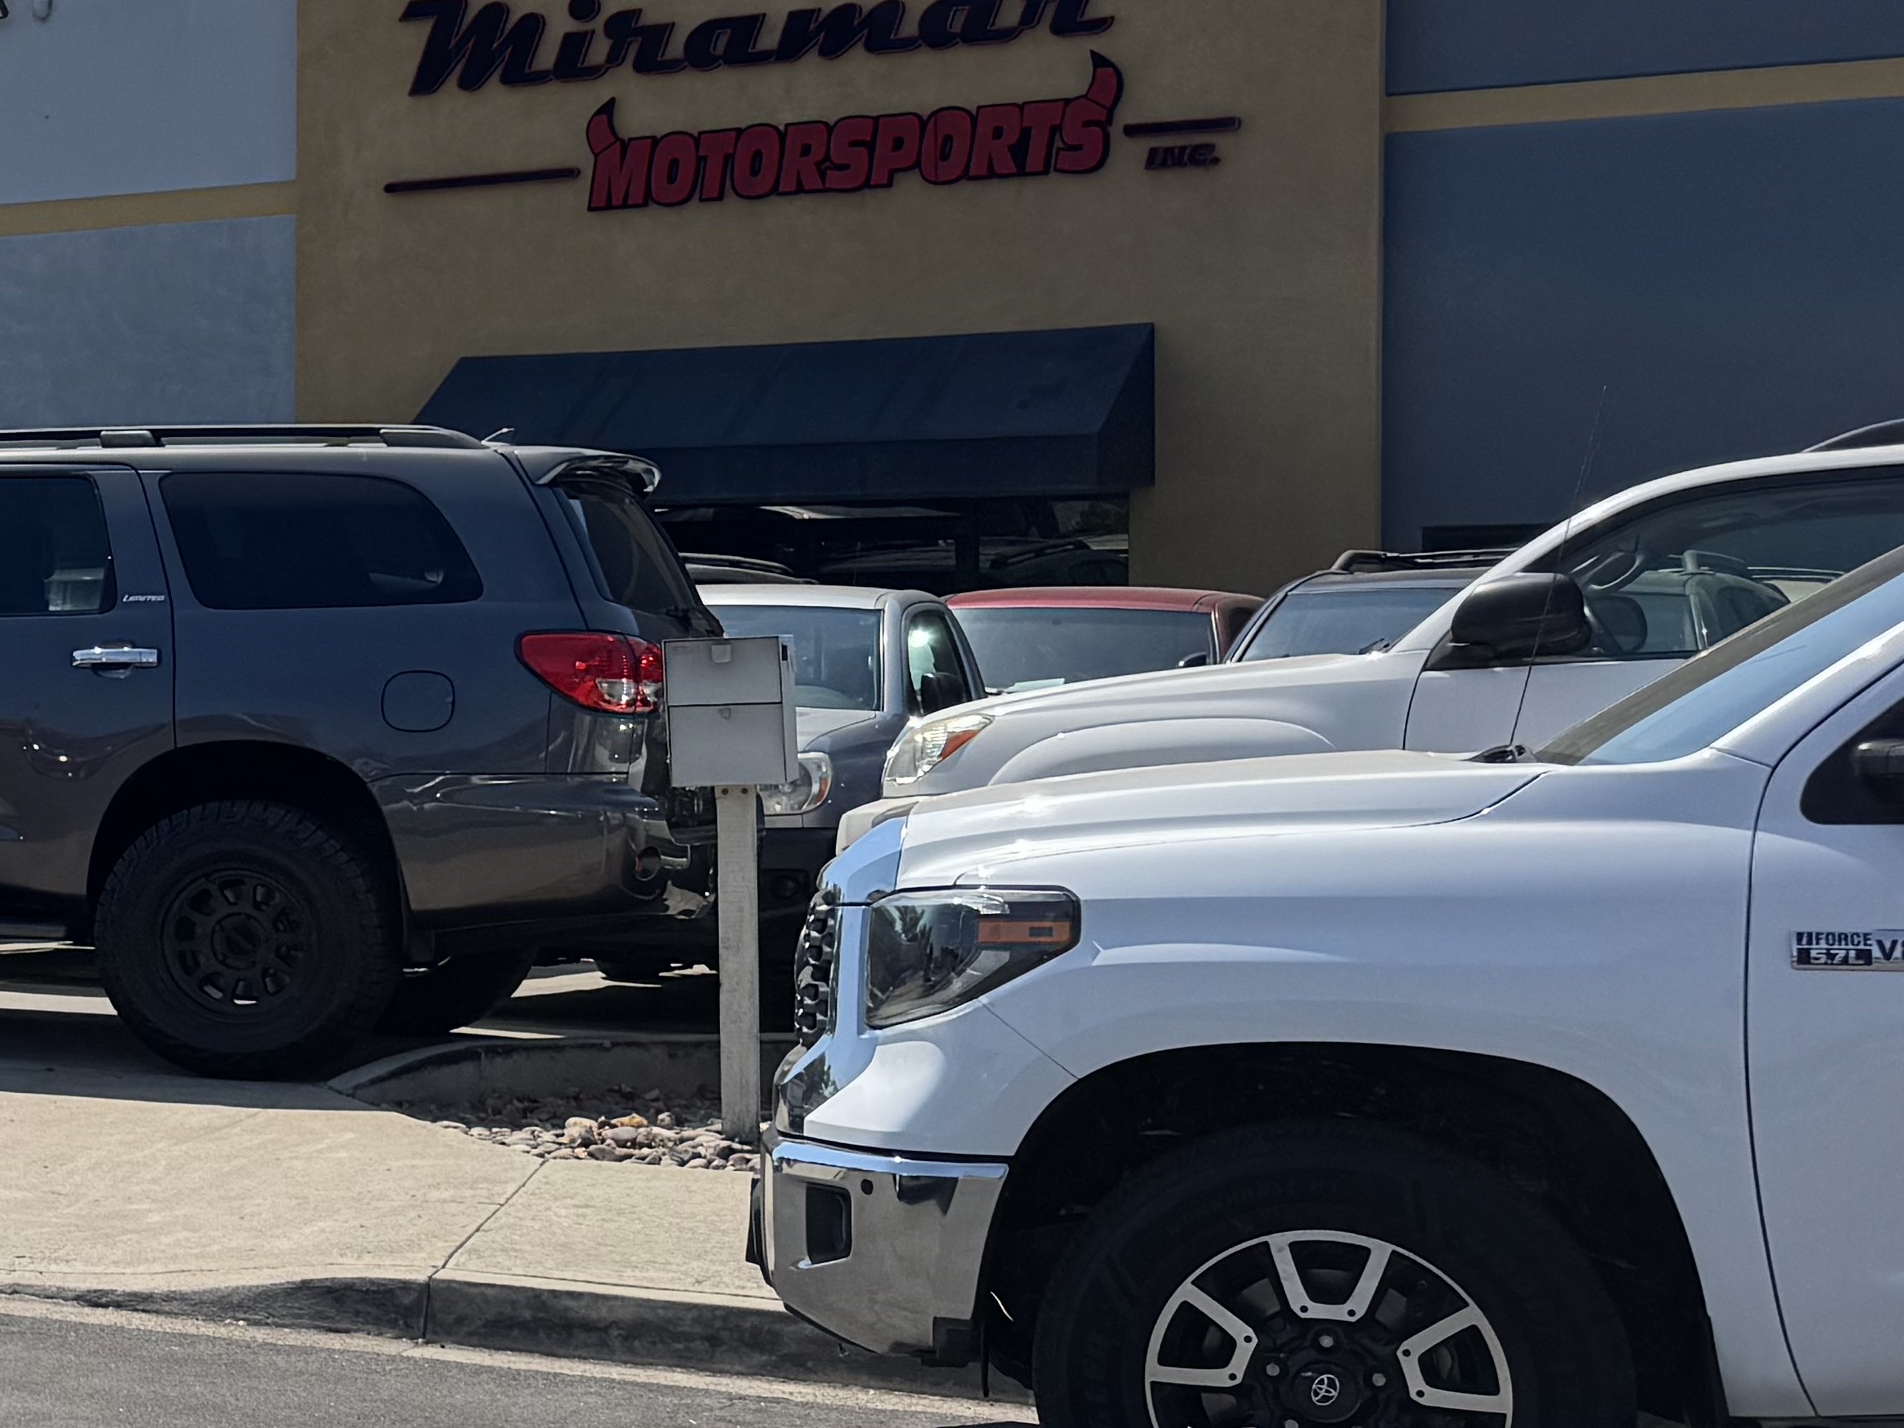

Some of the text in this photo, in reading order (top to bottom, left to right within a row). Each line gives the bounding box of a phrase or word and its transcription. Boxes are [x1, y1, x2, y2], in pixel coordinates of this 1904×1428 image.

[586, 62, 1122, 212] MOTORSPORTS
[1809, 949, 1865, 965] 5.7L
[1875, 938, 1904, 962] V
